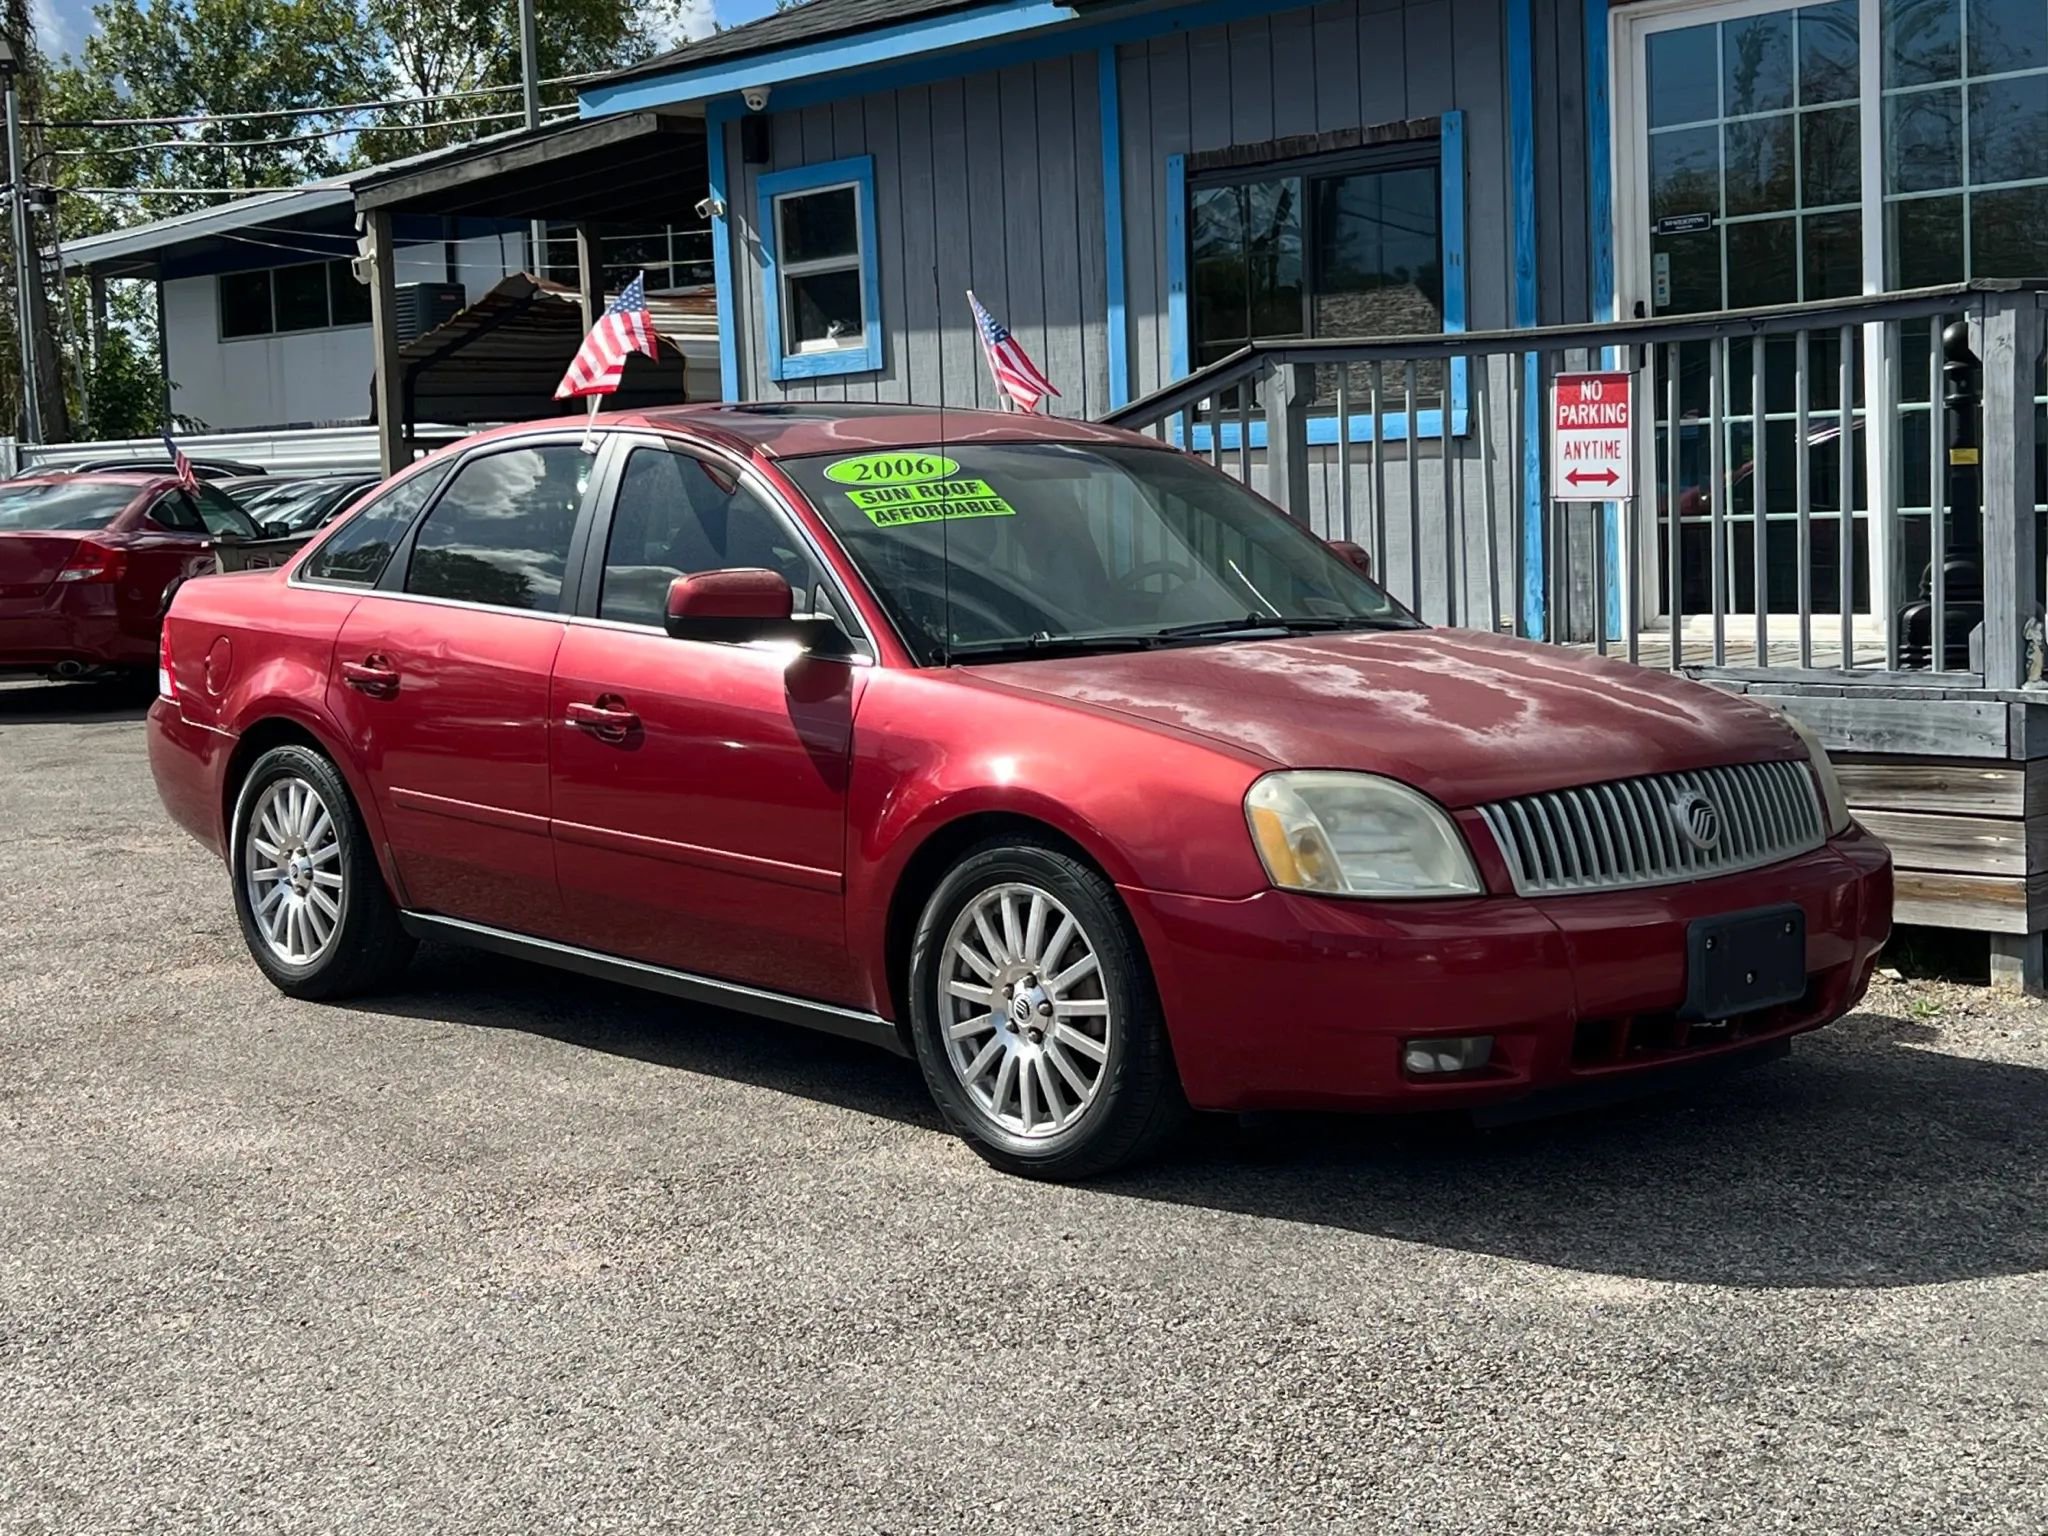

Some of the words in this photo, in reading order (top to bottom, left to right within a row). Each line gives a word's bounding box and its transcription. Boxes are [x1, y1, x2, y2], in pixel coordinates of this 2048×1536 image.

[1580, 380, 1602, 401] NO
[1559, 403, 1627, 425] PARKING
[1564, 440, 1621, 459] ANYTIME
[853, 458, 934, 481] 2006
[860, 487, 910, 504] SUN
[918, 482, 980, 499] ROOF
[875, 500, 1005, 523] AFFORDABLE
